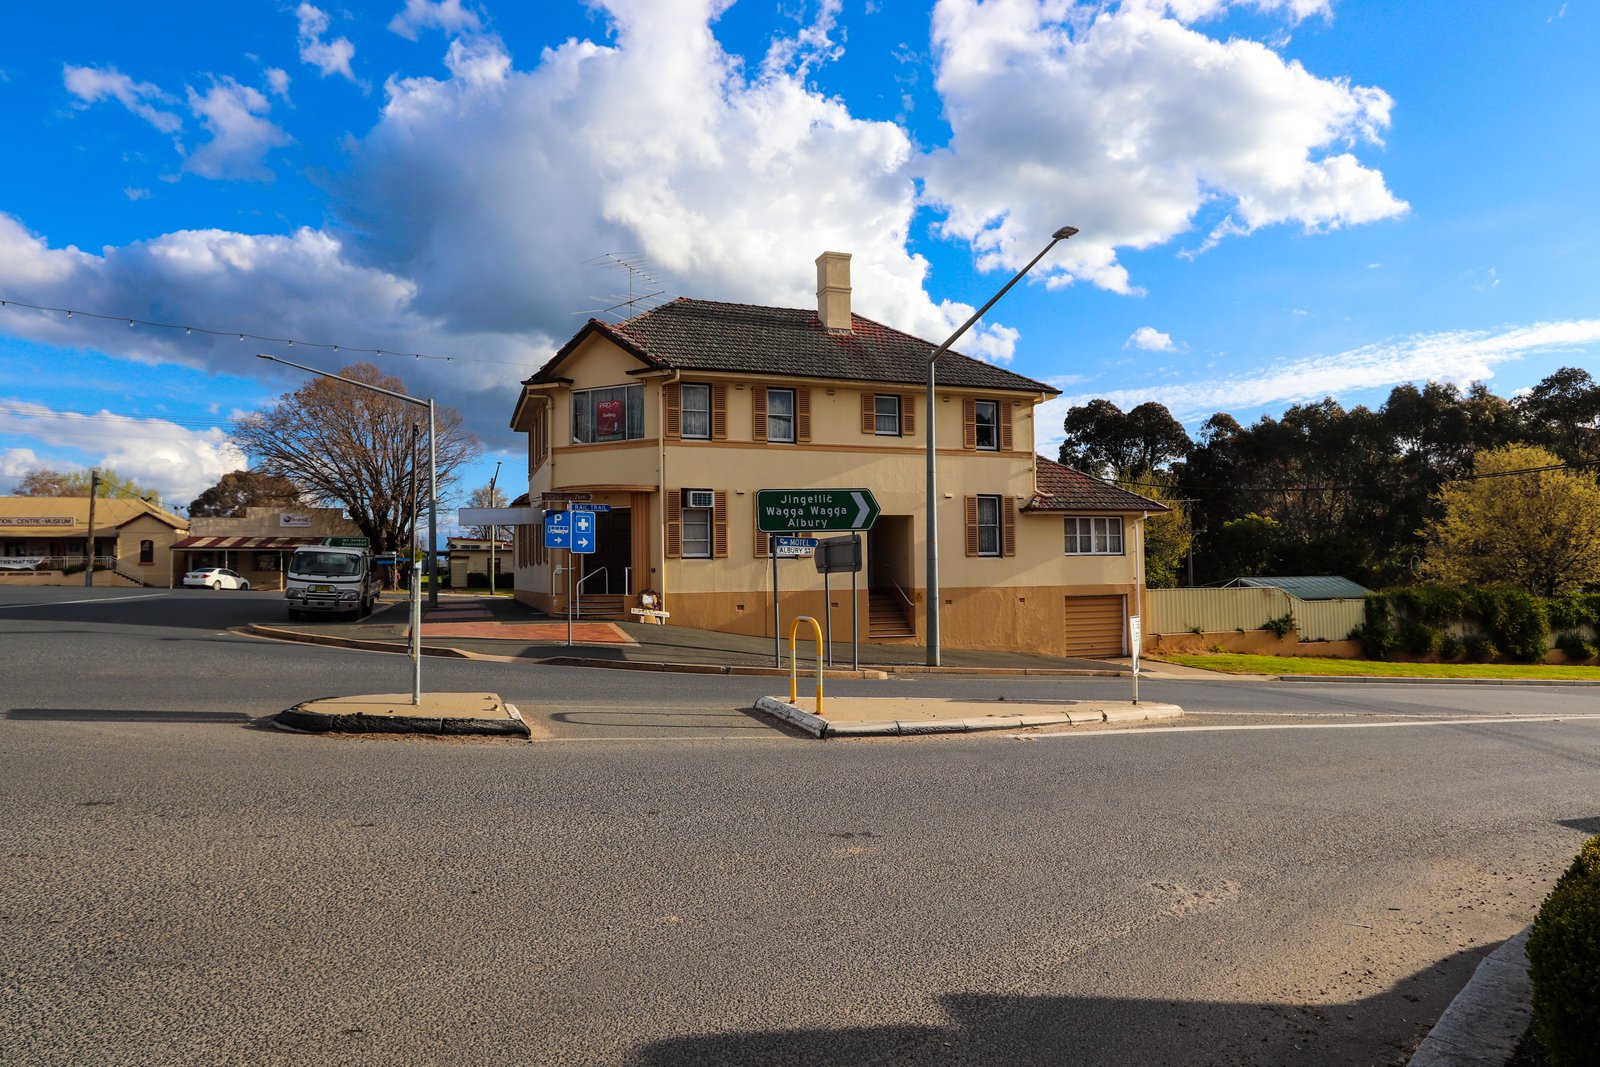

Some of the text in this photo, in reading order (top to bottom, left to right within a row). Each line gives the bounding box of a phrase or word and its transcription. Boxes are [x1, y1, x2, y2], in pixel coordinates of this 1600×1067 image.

[780, 494, 833, 506] Jingellic
[766, 506, 848, 518] Wagga Wagga
[554, 514, 563, 524] P
[787, 518, 828, 528] Albury
[789, 538, 810, 547] MOTEL
